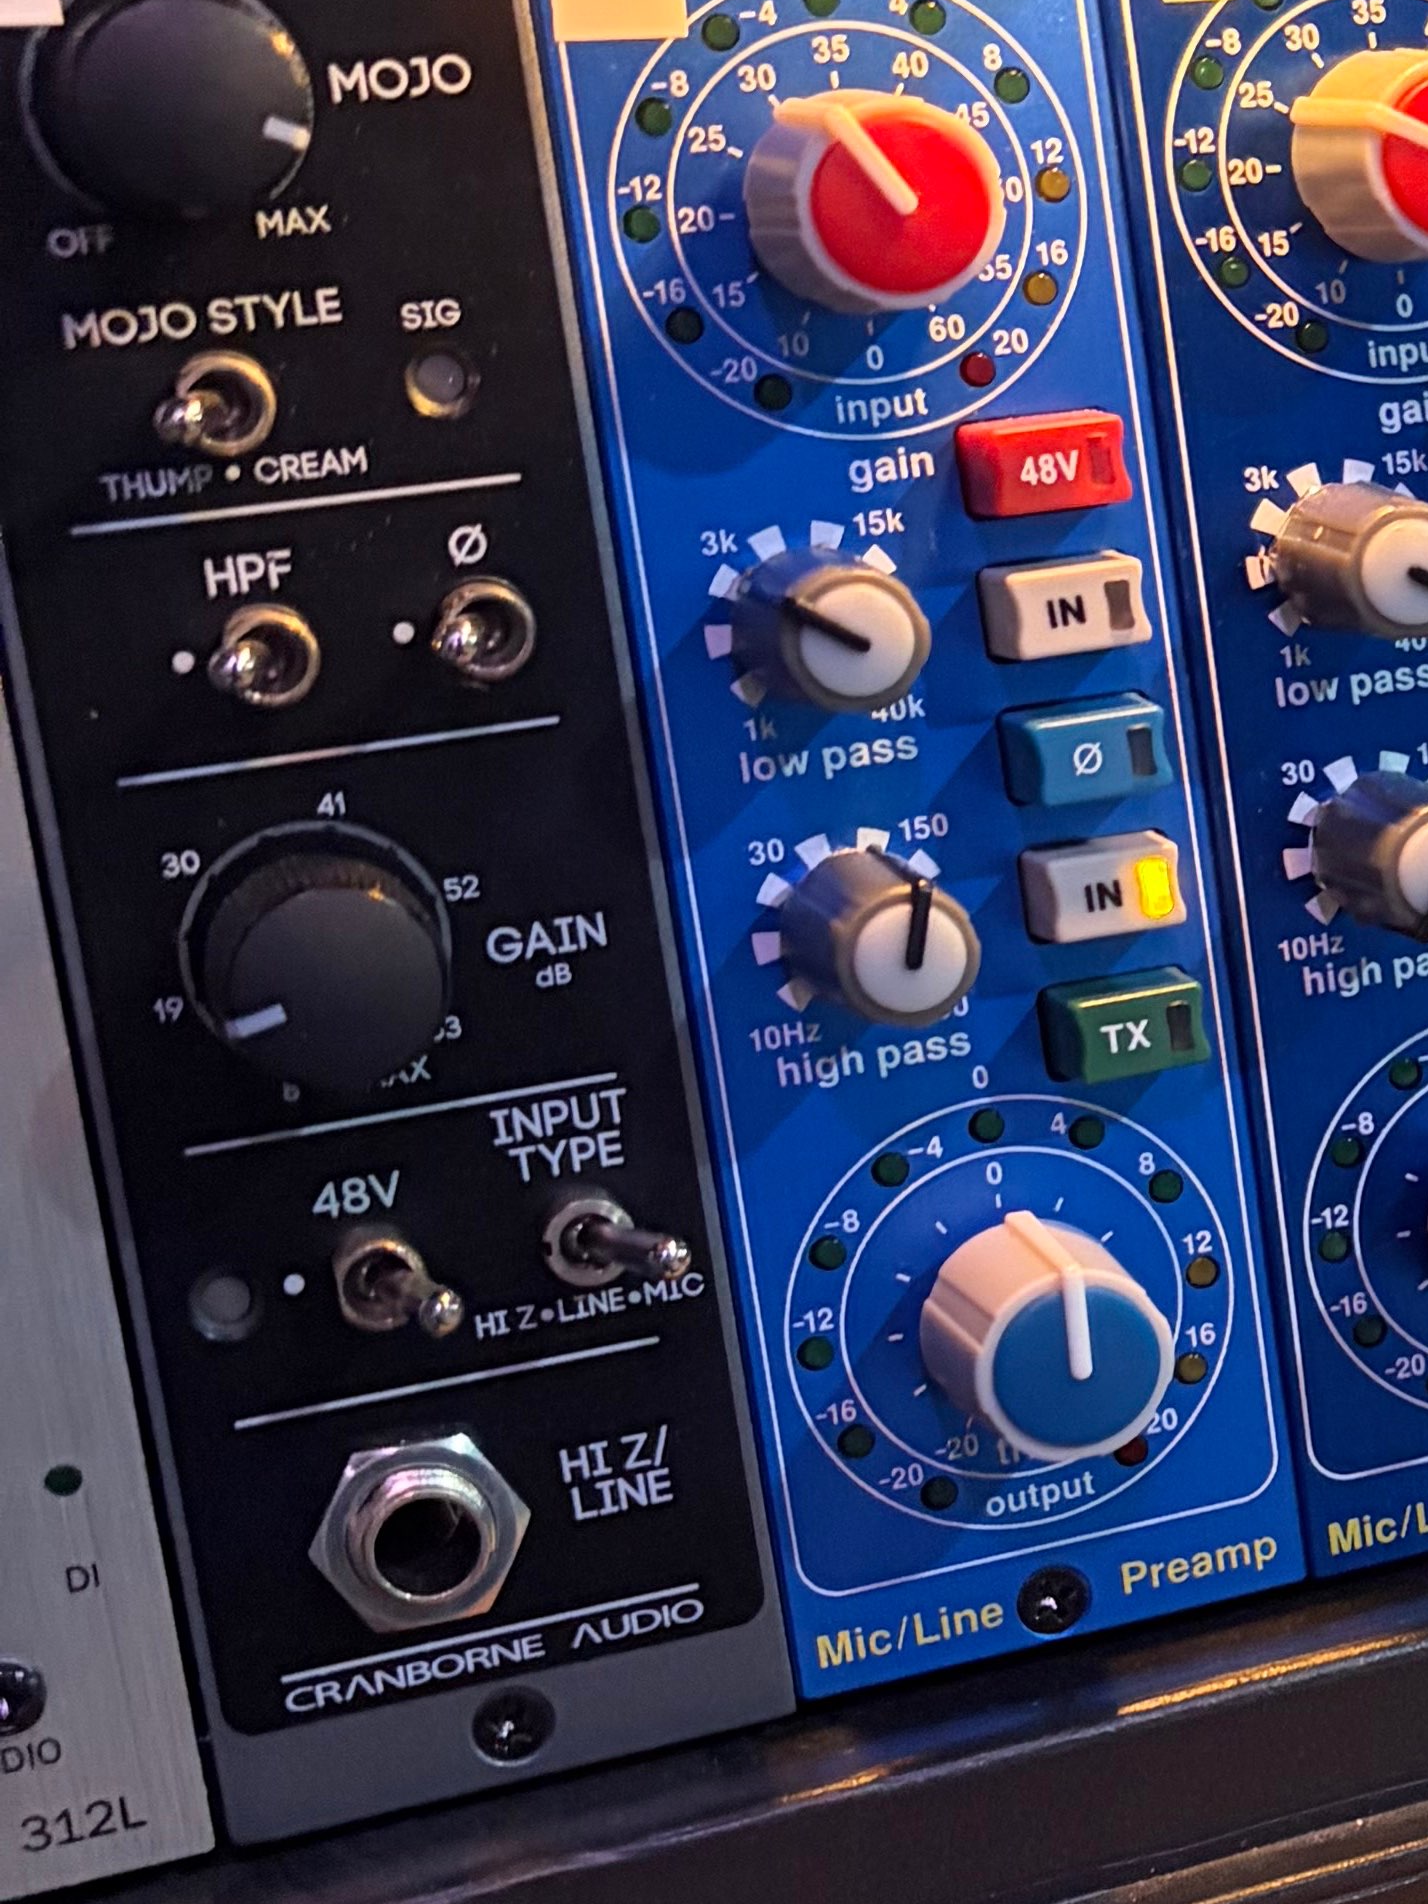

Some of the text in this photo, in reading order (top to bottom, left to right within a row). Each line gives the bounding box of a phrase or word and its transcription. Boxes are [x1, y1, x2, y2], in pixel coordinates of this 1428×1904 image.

[812, 36, 850, 64] 35
[892, 51, 929, 79] 40
[328, 54, 472, 104] MOJO
[739, 64, 776, 92] 30
[1238, 81, 1273, 108] 25
[688, 126, 727, 155] 25
[256, 205, 331, 239] MAX
[62, 288, 342, 349] MOJO STYLE
[401, 300, 461, 330] SIG
[835, 388, 928, 428] input
[101, 446, 368, 502] THUMP CREAM
[849, 449, 935, 494] gain
[1020, 450, 1079, 486] 48V
[853, 510, 905, 536] 15k
[701, 530, 737, 557] 3k
[204, 550, 292, 598] HPF
[1046, 596, 1087, 630] IN
[1274, 677, 1338, 708] low
[740, 736, 918, 783] low pass
[899, 814, 949, 842] 150
[161, 850, 200, 878] 30
[748, 838, 785, 865] 30
[443, 876, 480, 901] 52
[1084, 880, 1123, 913] IN
[486, 914, 607, 964] GAIN
[536, 962, 572, 989] dB
[1303, 958, 1383, 997] high
[749, 1021, 822, 1052] 10Hz
[1100, 1020, 1152, 1051] TX
[777, 1032, 971, 1088] high pass
[490, 1088, 626, 1148] INPUT
[509, 1130, 625, 1183] TYPE
[313, 1170, 399, 1218] 48V
[474, 1309, 510, 1340] HI
[559, 1449, 611, 1485] HI
[571, 1470, 674, 1521] LINE
[985, 1472, 1096, 1517] output
[66, 1565, 99, 1594] DI
[816, 1534, 1279, 1669] Mic/Line Preamp
[286, 1598, 705, 1714] CRANBORNE AUDIO
[21, 1797, 148, 1852] 312L
